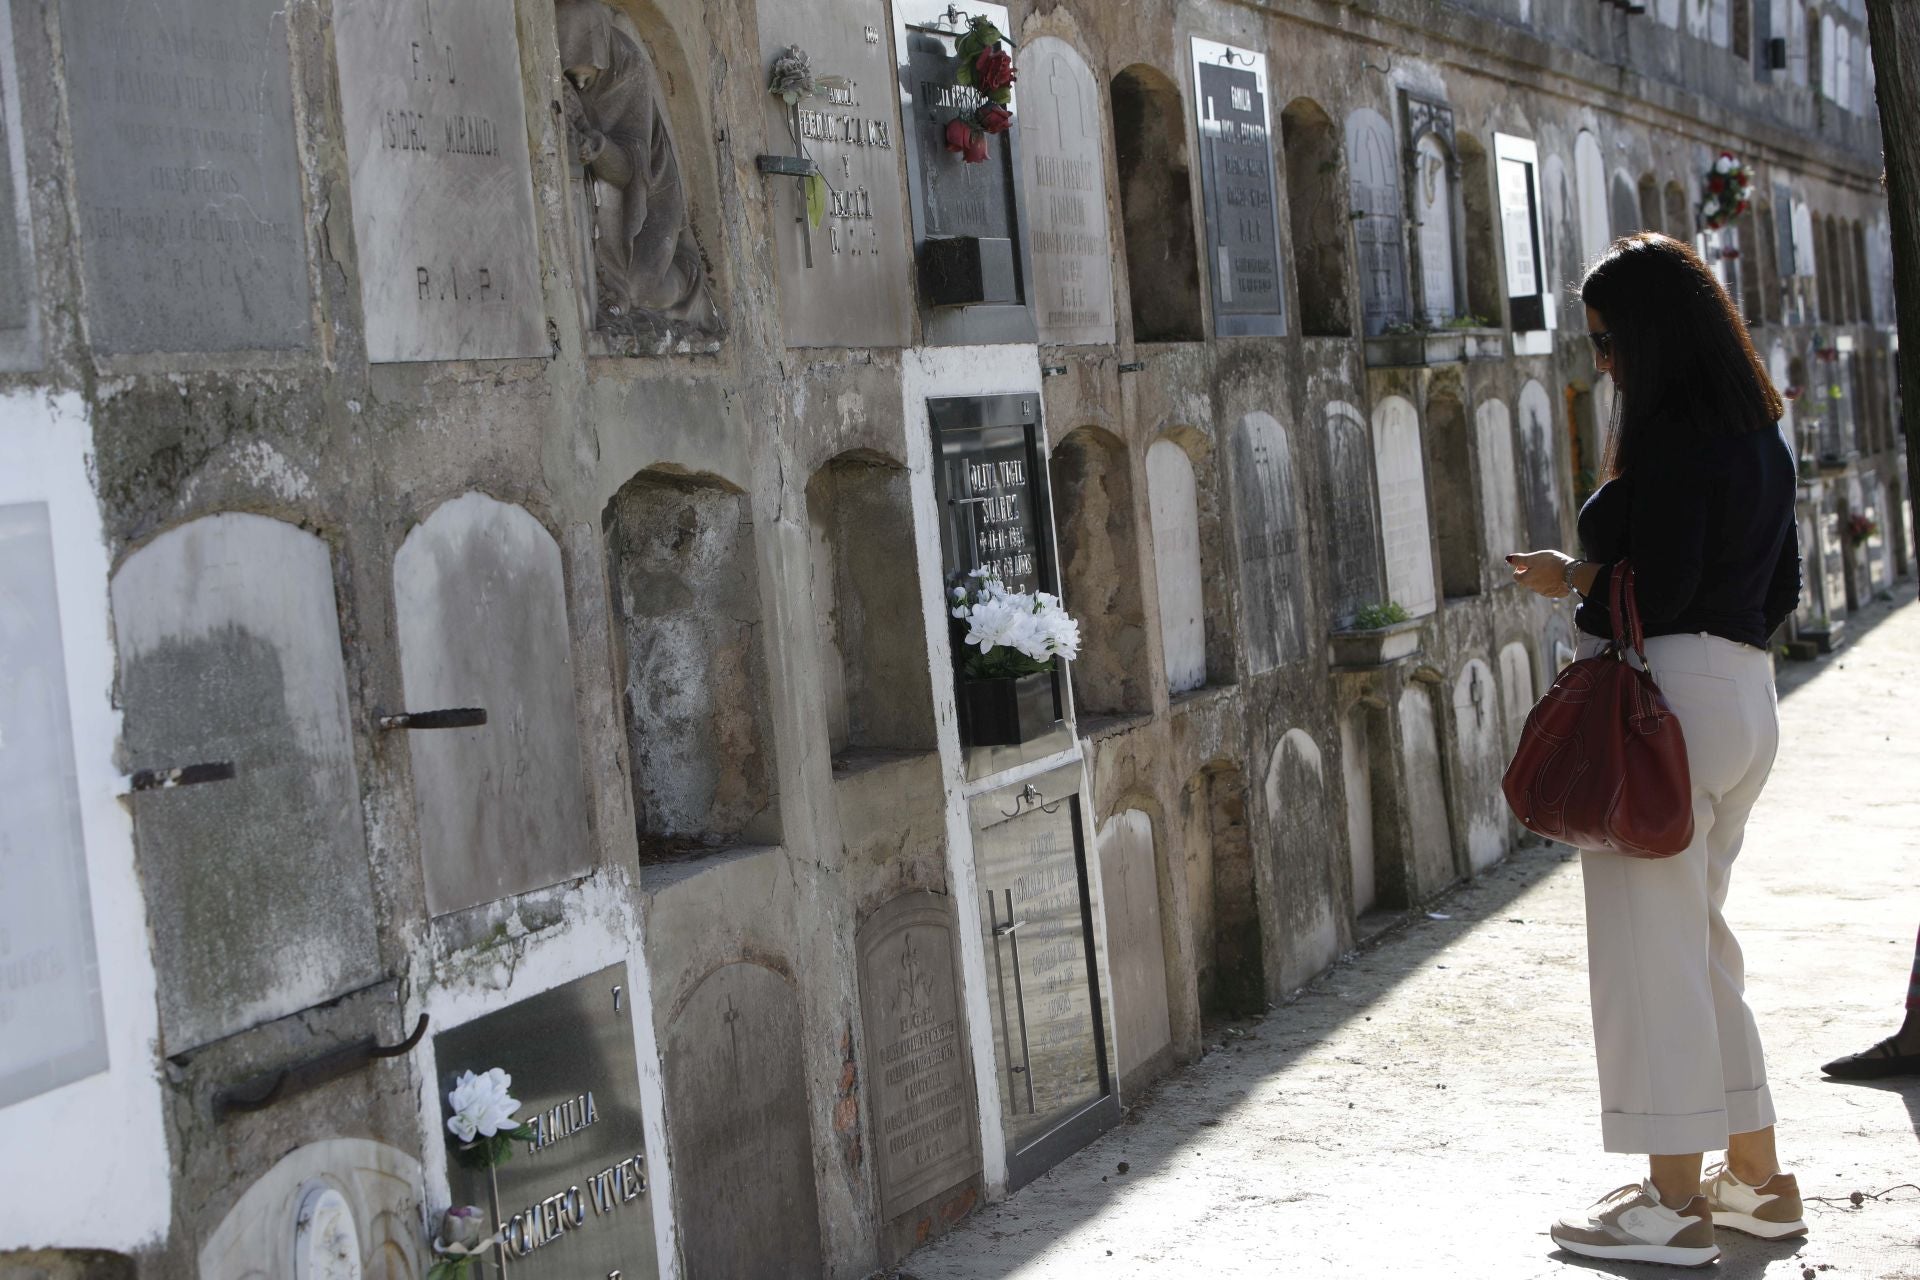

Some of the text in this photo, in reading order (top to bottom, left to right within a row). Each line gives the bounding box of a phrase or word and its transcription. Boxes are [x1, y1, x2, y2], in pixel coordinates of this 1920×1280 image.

[970, 460, 1026, 492] OLIVA VIGIL
[982, 494, 1020, 524] SUAREZ
[527, 1091, 600, 1154] FAMILIA
[500, 1154, 648, 1261] ROMERO VIVES
